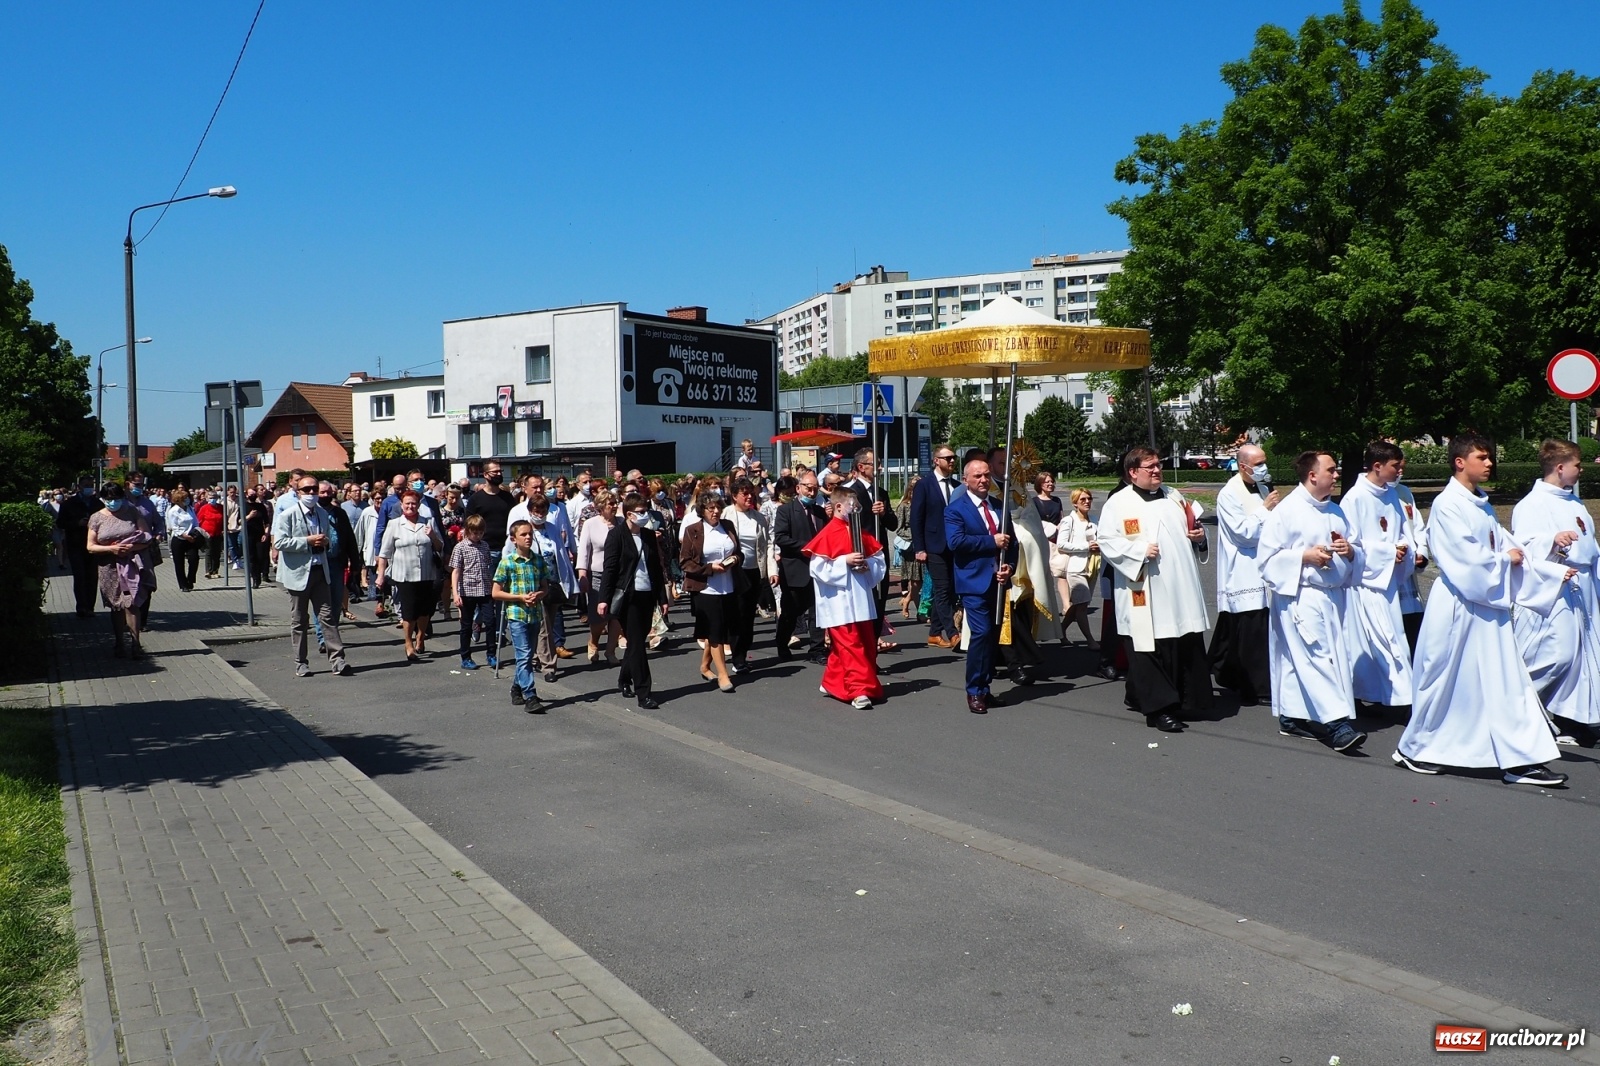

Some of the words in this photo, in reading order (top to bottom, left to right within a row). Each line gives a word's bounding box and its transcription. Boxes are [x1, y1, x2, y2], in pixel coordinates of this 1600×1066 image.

[651, 329, 662, 338] jest
[662, 330, 682, 341] bardzo
[683, 334, 699, 343] dobre
[1005, 337, 1030, 350] ZBAW
[1036, 337, 1058, 350] MNIE
[669, 344, 709, 363] Miejsce
[712, 351, 725, 363] na
[682, 360, 714, 380] Twoją
[716, 364, 758, 383] reklamę
[498, 386, 512, 418] 7
[687, 383, 709, 400] 666
[712, 384, 732, 402] 371
[737, 386, 757, 403] 352
[662, 414, 715, 425] KLEOPATRA
